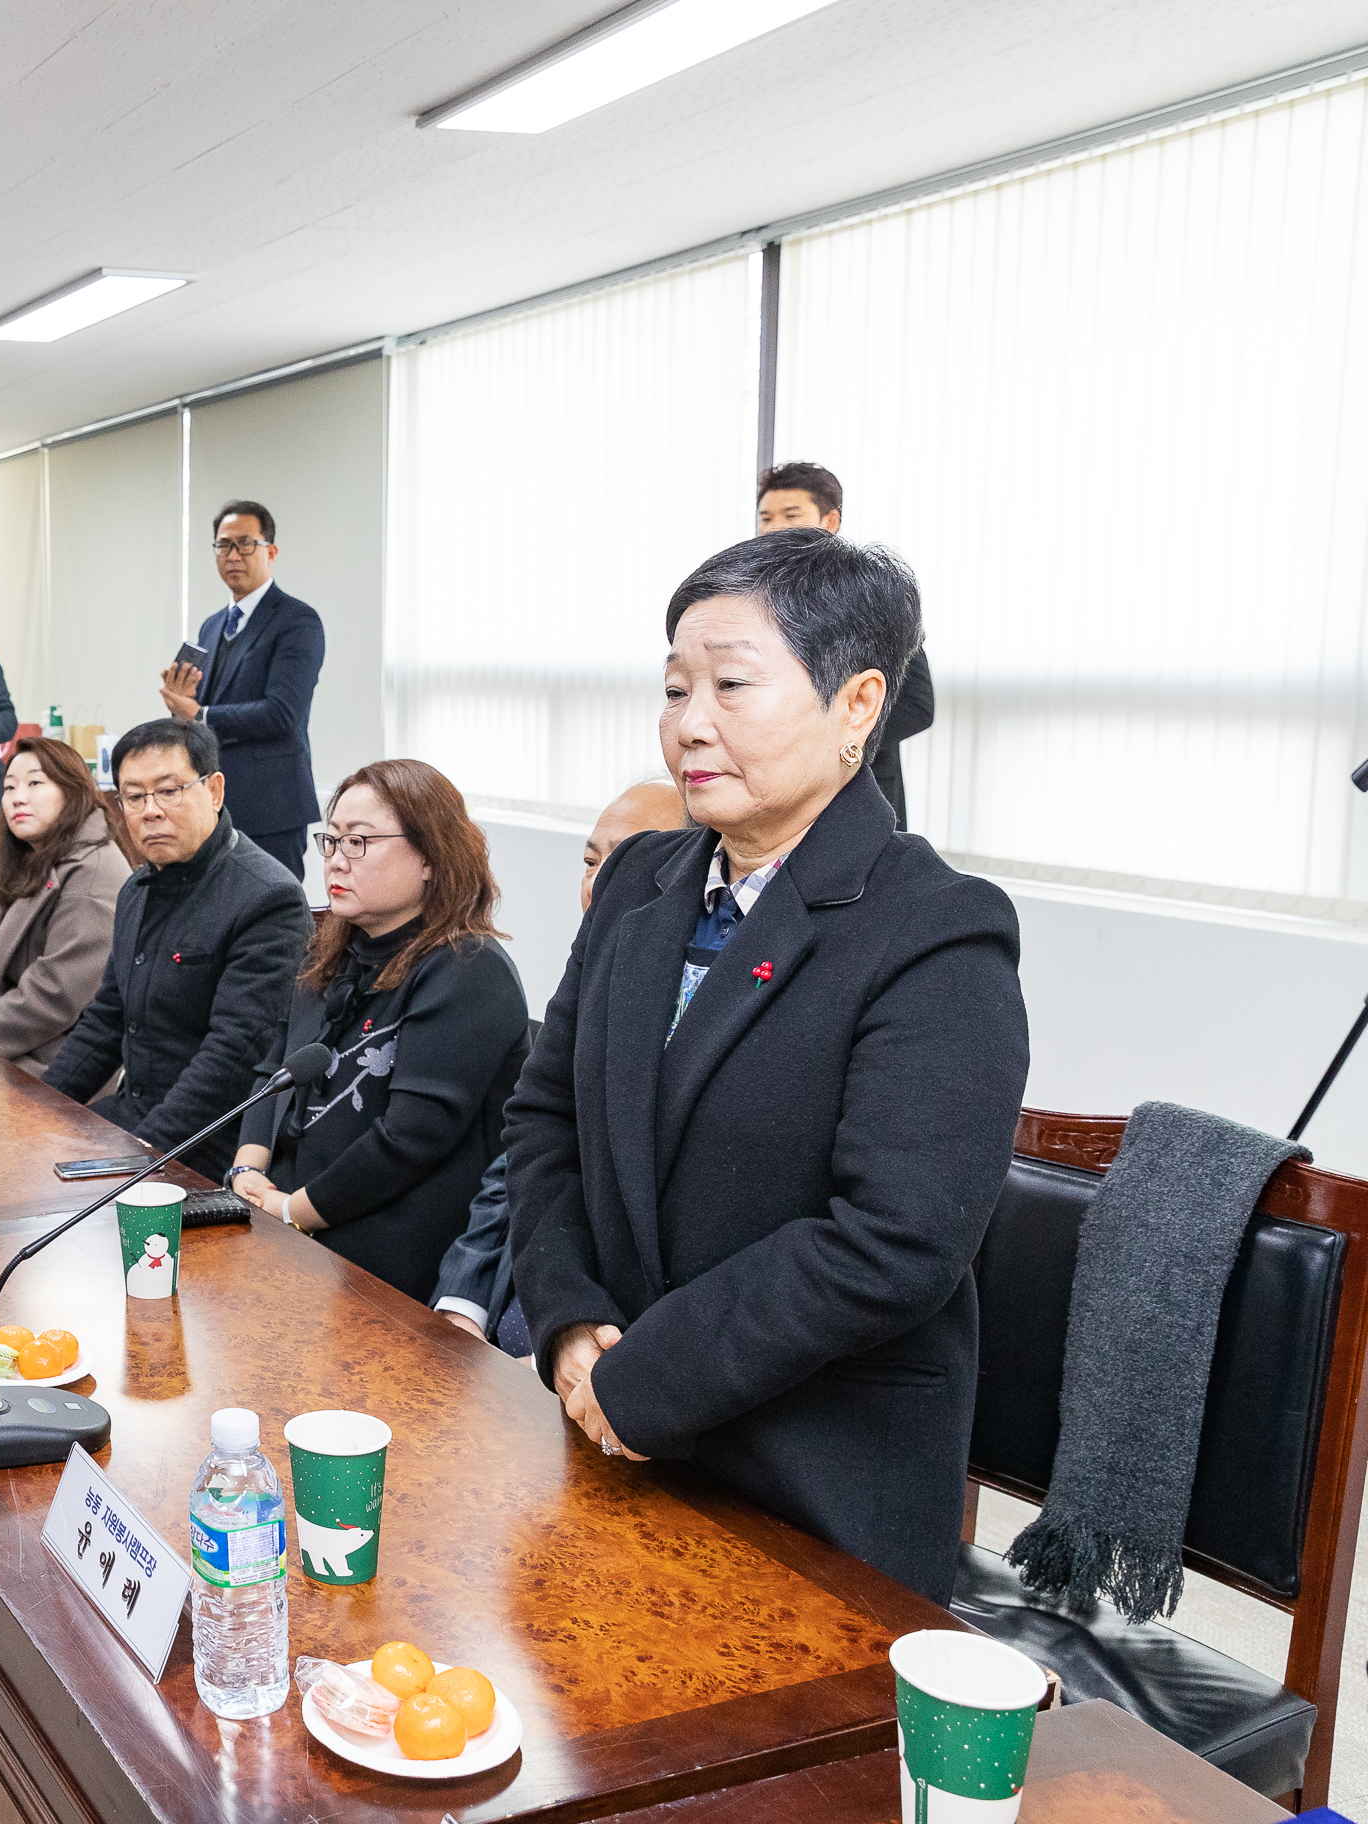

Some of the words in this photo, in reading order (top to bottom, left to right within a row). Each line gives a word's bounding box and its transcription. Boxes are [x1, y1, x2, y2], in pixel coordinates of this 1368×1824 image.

[77, 1520, 92, 1561] 윤
[99, 1550, 116, 1590] 애
[84, 1486, 103, 1516] 능동
[100, 1505, 158, 1579] 자원봉사캠프장
